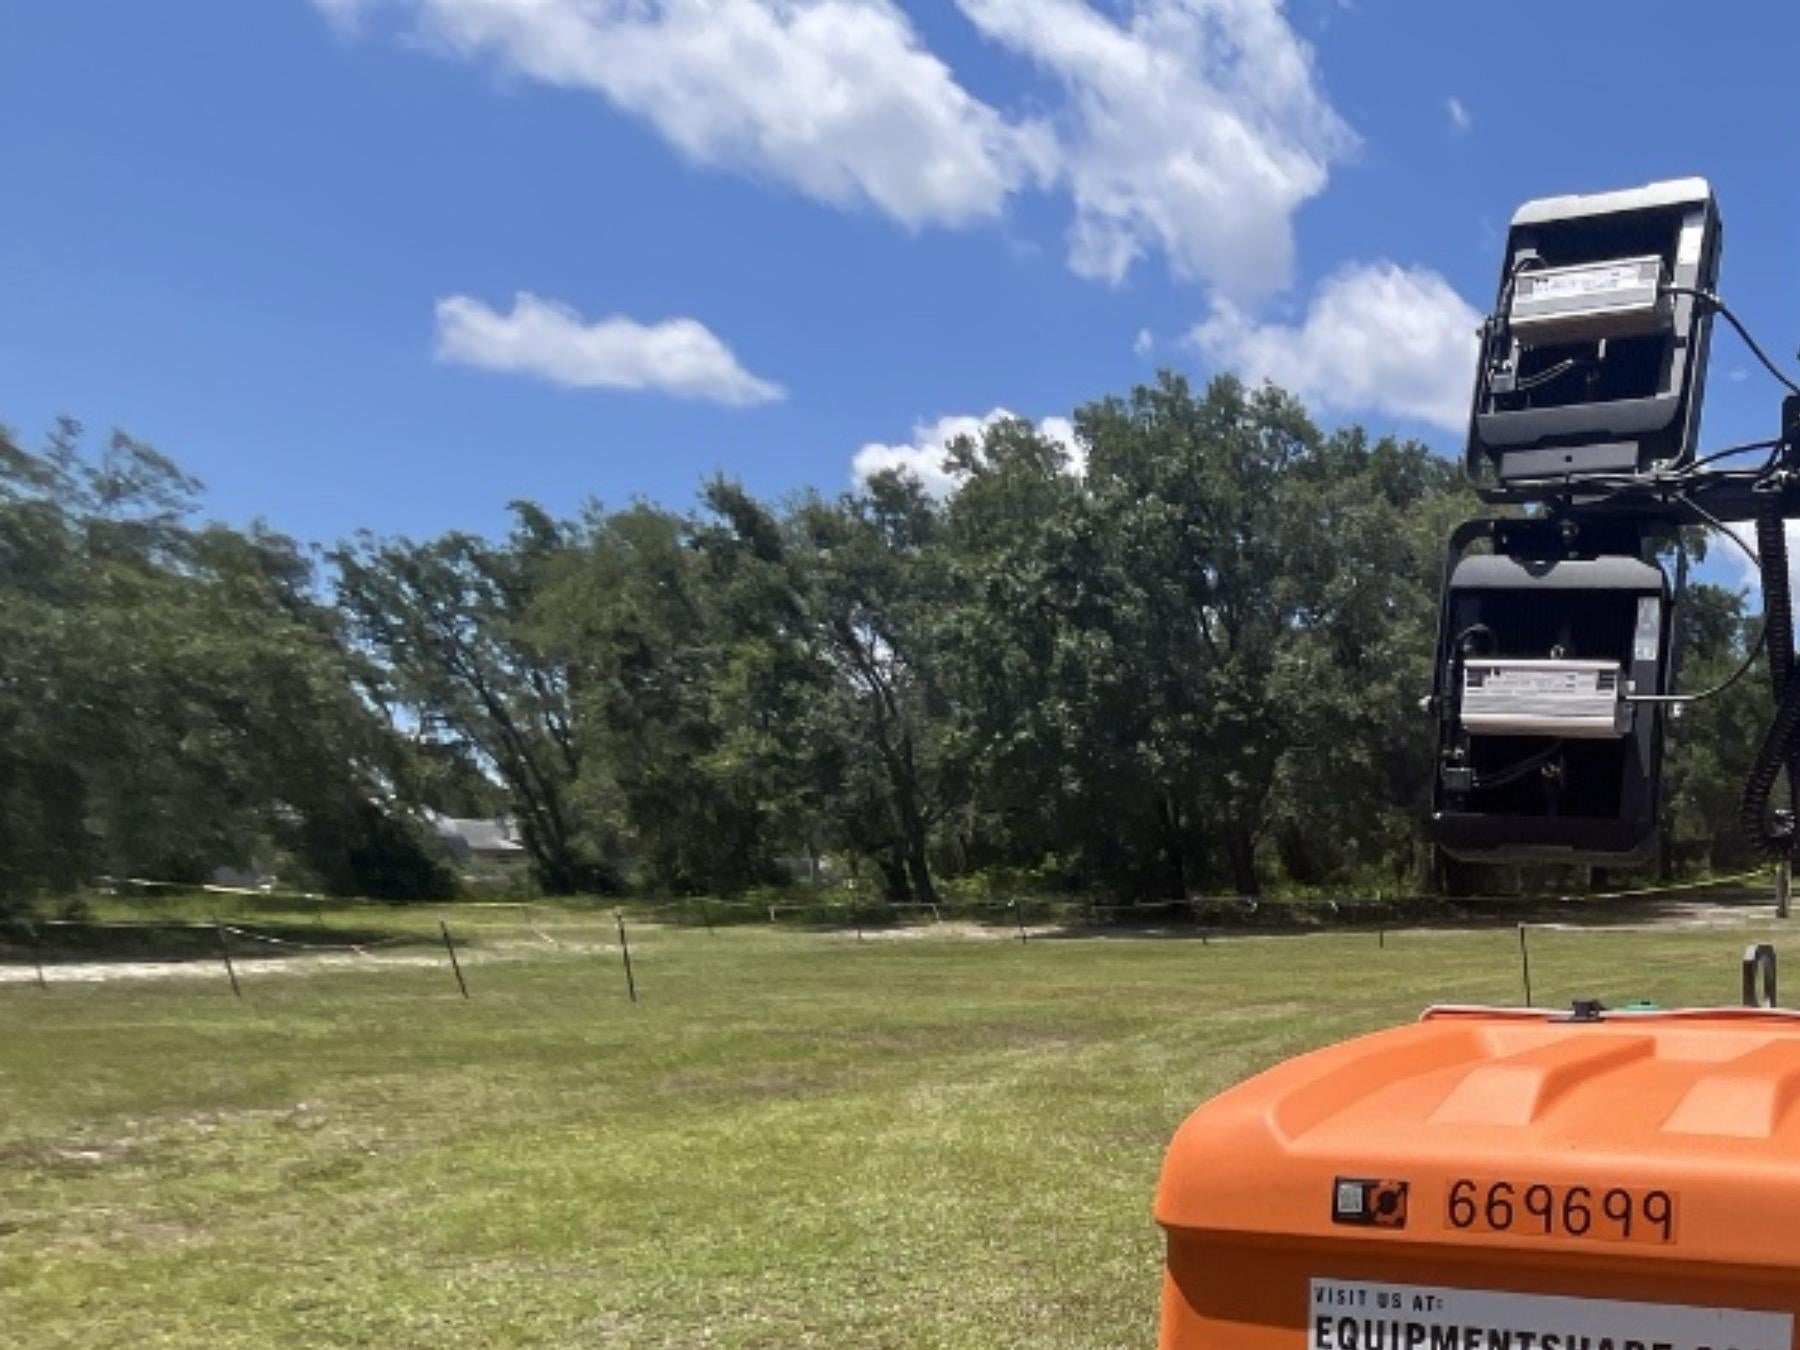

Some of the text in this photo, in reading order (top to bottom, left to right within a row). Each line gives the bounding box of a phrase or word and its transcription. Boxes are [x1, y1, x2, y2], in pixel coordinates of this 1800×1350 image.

[1448, 1178, 1673, 1240] 669699
[1314, 1286, 1443, 1312] VISIT US AT:
